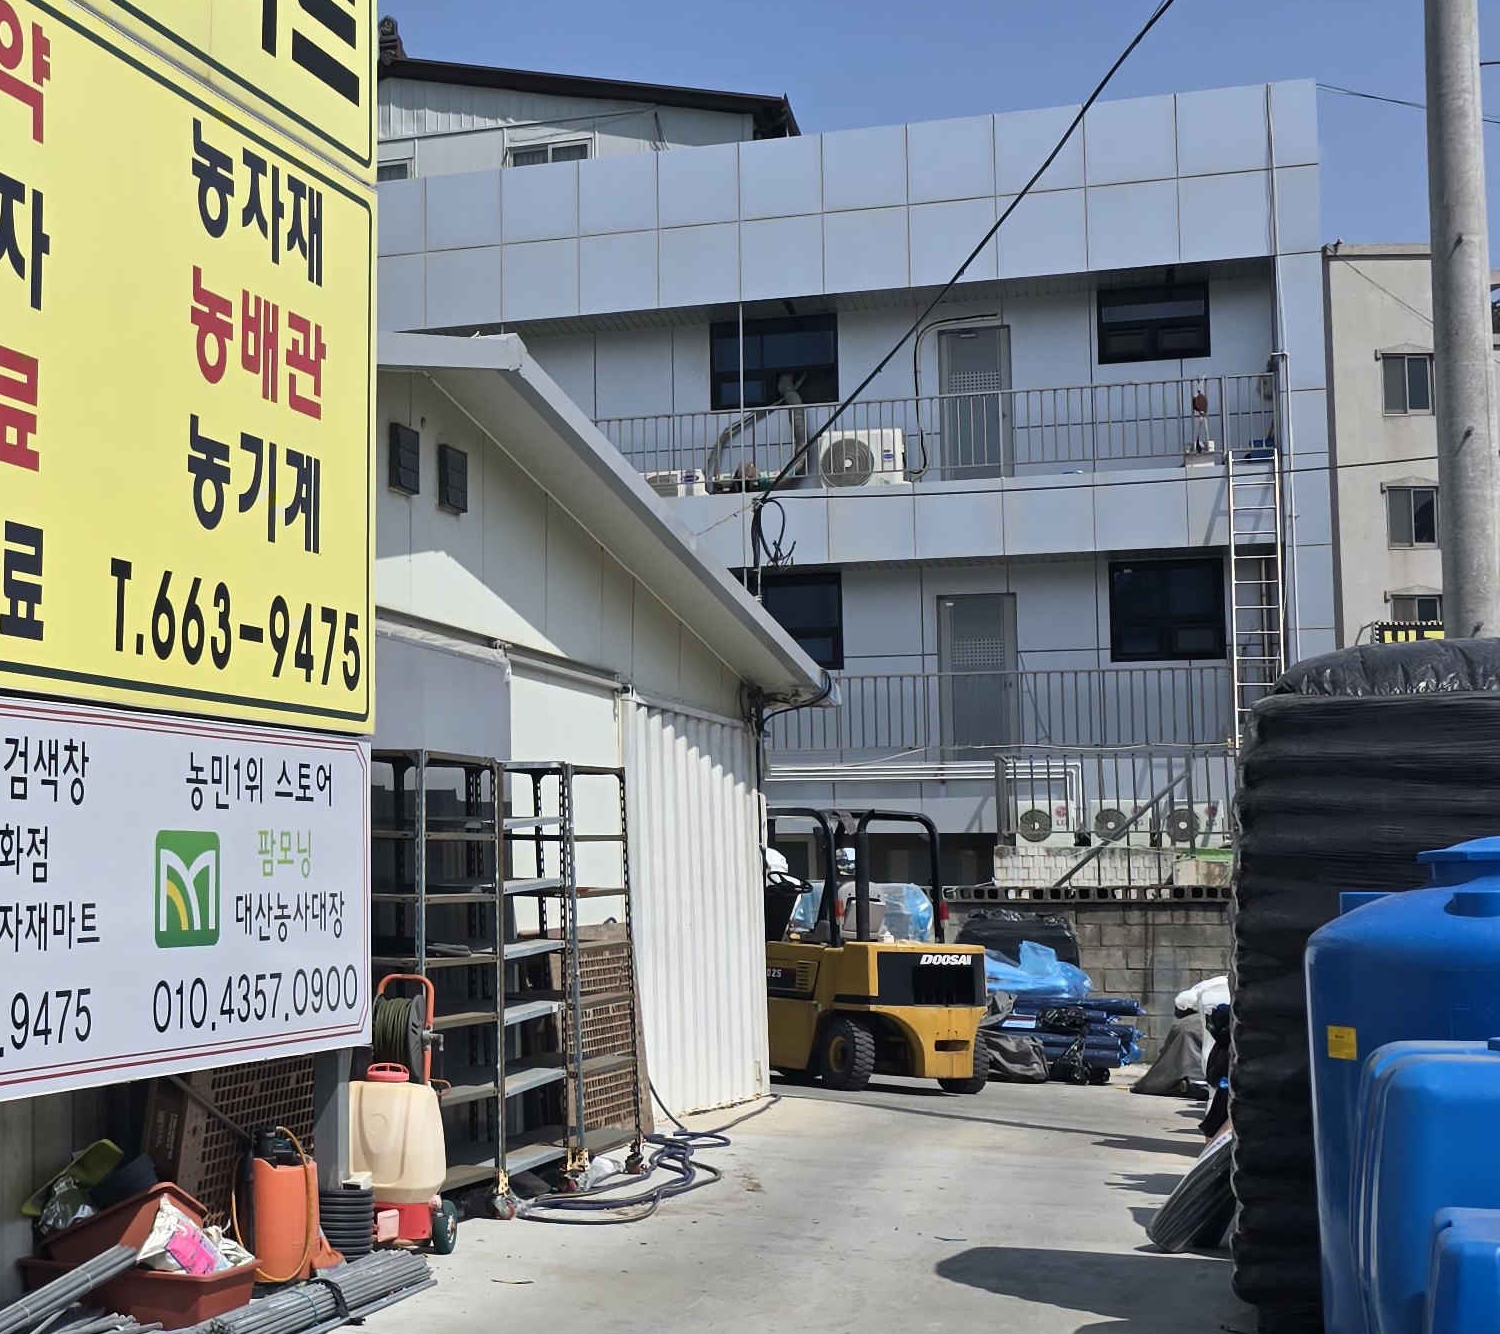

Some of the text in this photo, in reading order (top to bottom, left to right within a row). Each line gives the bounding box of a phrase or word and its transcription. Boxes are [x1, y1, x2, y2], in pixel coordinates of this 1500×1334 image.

[192, 118, 324, 287] 농자재
[190, 265, 326, 421] 농배관
[188, 414, 323, 554] 농기계
[111, 558, 361, 693] T.663-9475
[3, 736, 89, 805] 검색창
[185, 751, 333, 811] 농민1위 스토어
[258, 829, 311, 879] 팜모닝
[235, 890, 345, 943] 대산농사대장
[152, 964, 358, 1035] 010.4357.0900
